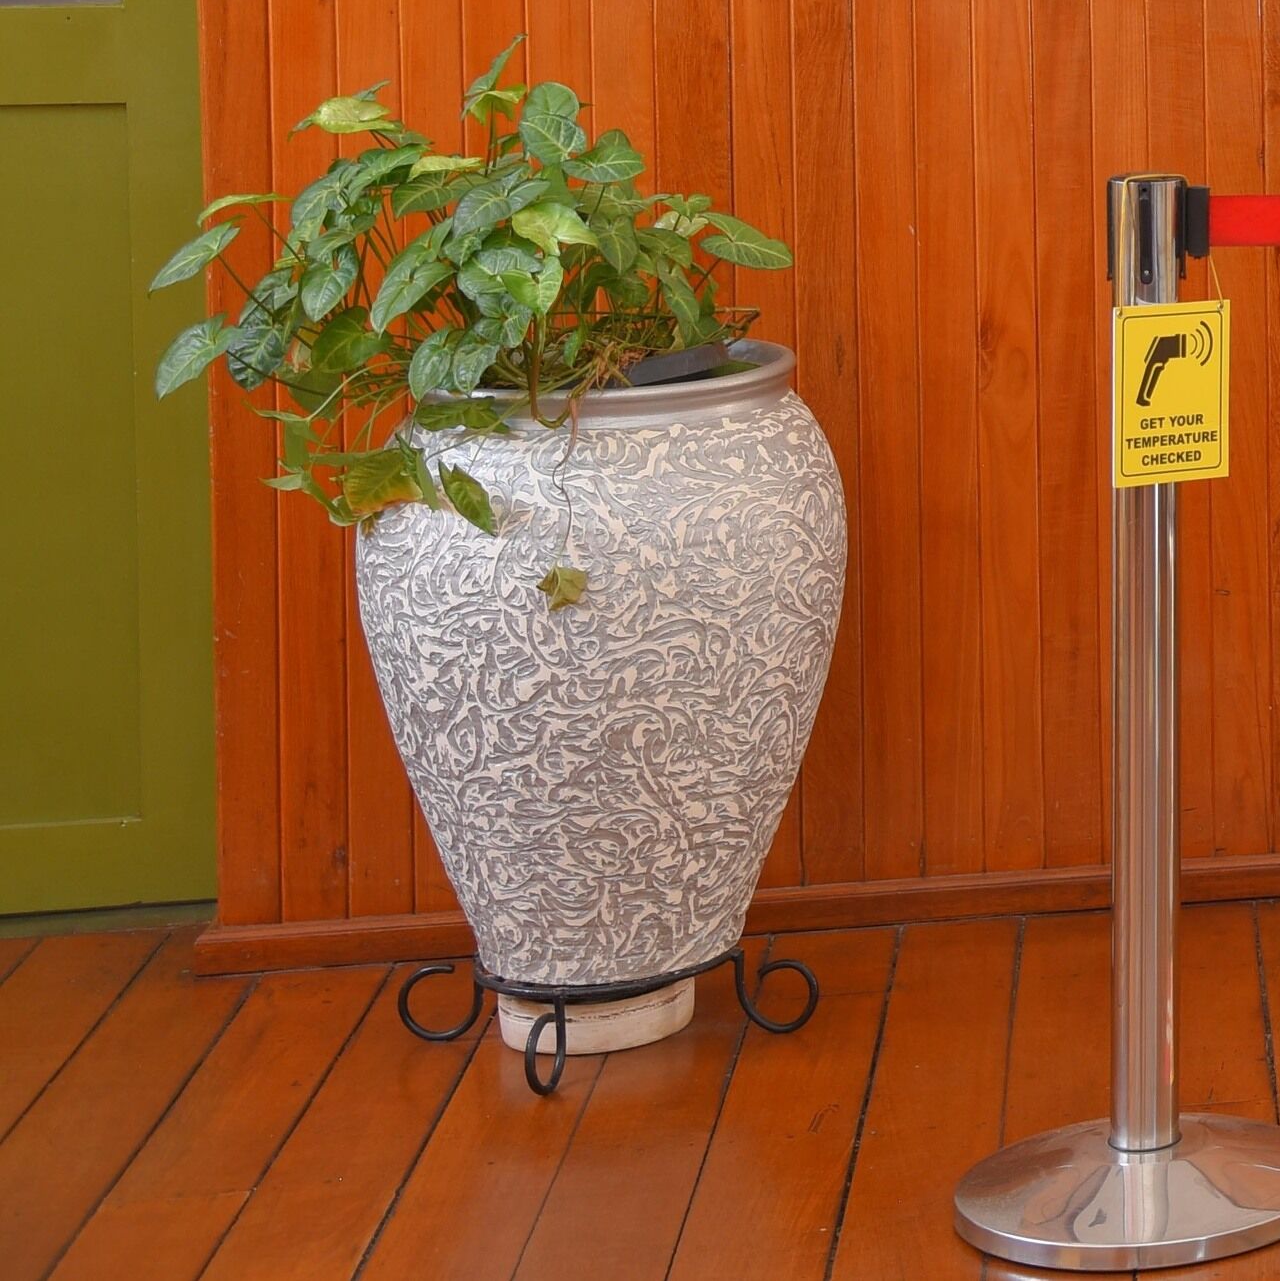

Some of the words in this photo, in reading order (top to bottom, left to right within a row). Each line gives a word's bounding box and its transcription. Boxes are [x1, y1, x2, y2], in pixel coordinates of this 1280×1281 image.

[1140, 417, 1165, 430] GET
[1169, 414, 1204, 427] YOUR
[1126, 430, 1218, 450] TEMPERATURE
[1141, 450, 1202, 466] CHECKED
